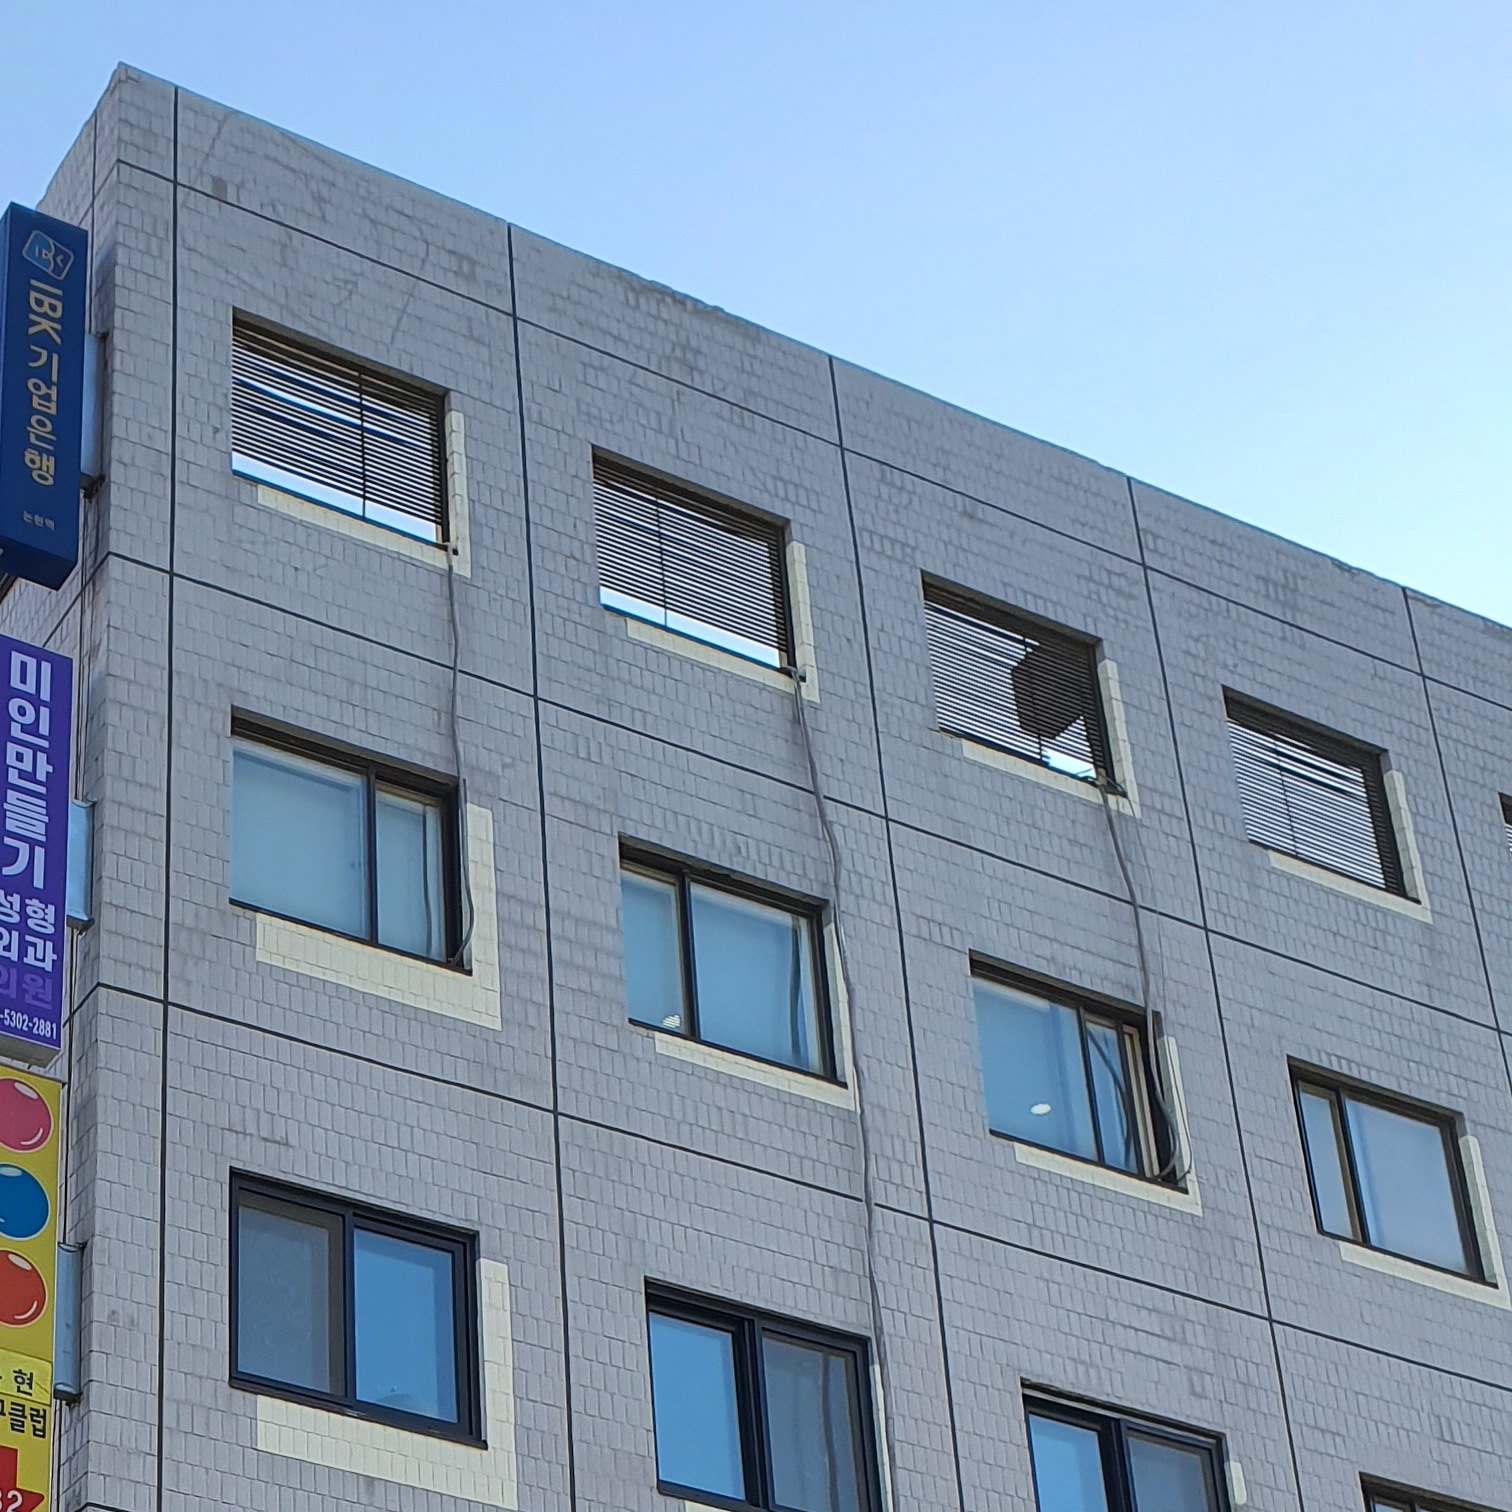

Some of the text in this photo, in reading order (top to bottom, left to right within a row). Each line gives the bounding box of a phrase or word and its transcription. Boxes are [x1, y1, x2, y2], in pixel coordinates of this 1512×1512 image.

[24, 278, 63, 486] IBK 기업은행
[1, 650, 54, 889] 미인만들기
